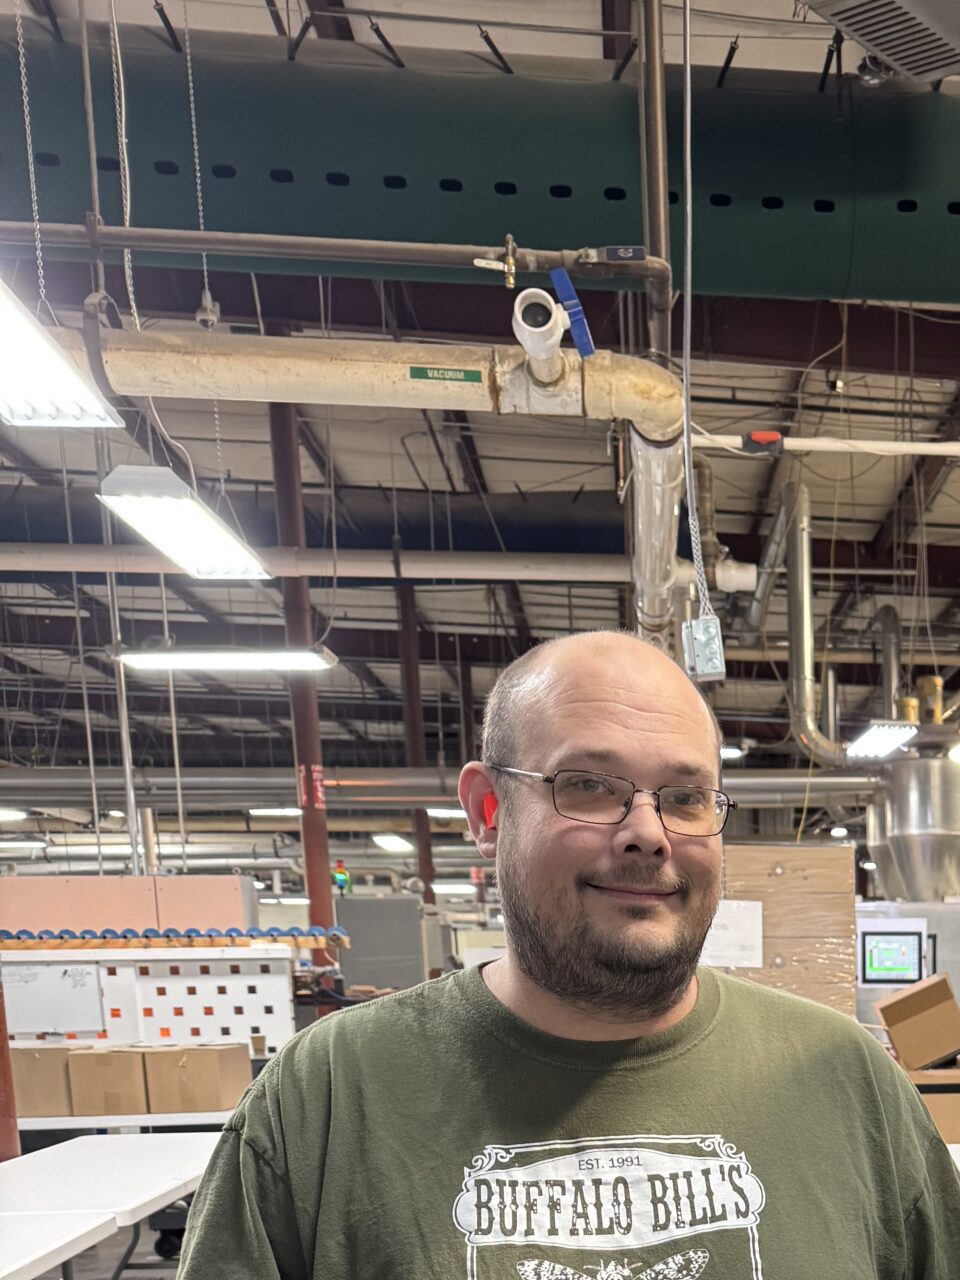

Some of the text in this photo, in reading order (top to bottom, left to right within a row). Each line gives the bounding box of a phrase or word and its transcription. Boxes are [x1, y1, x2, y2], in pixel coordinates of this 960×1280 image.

[427, 369, 465, 380] VACUUM
[578, 1155, 643, 1171] EST. 1991
[474, 1164, 751, 1237] BUFFALO BILL'S
